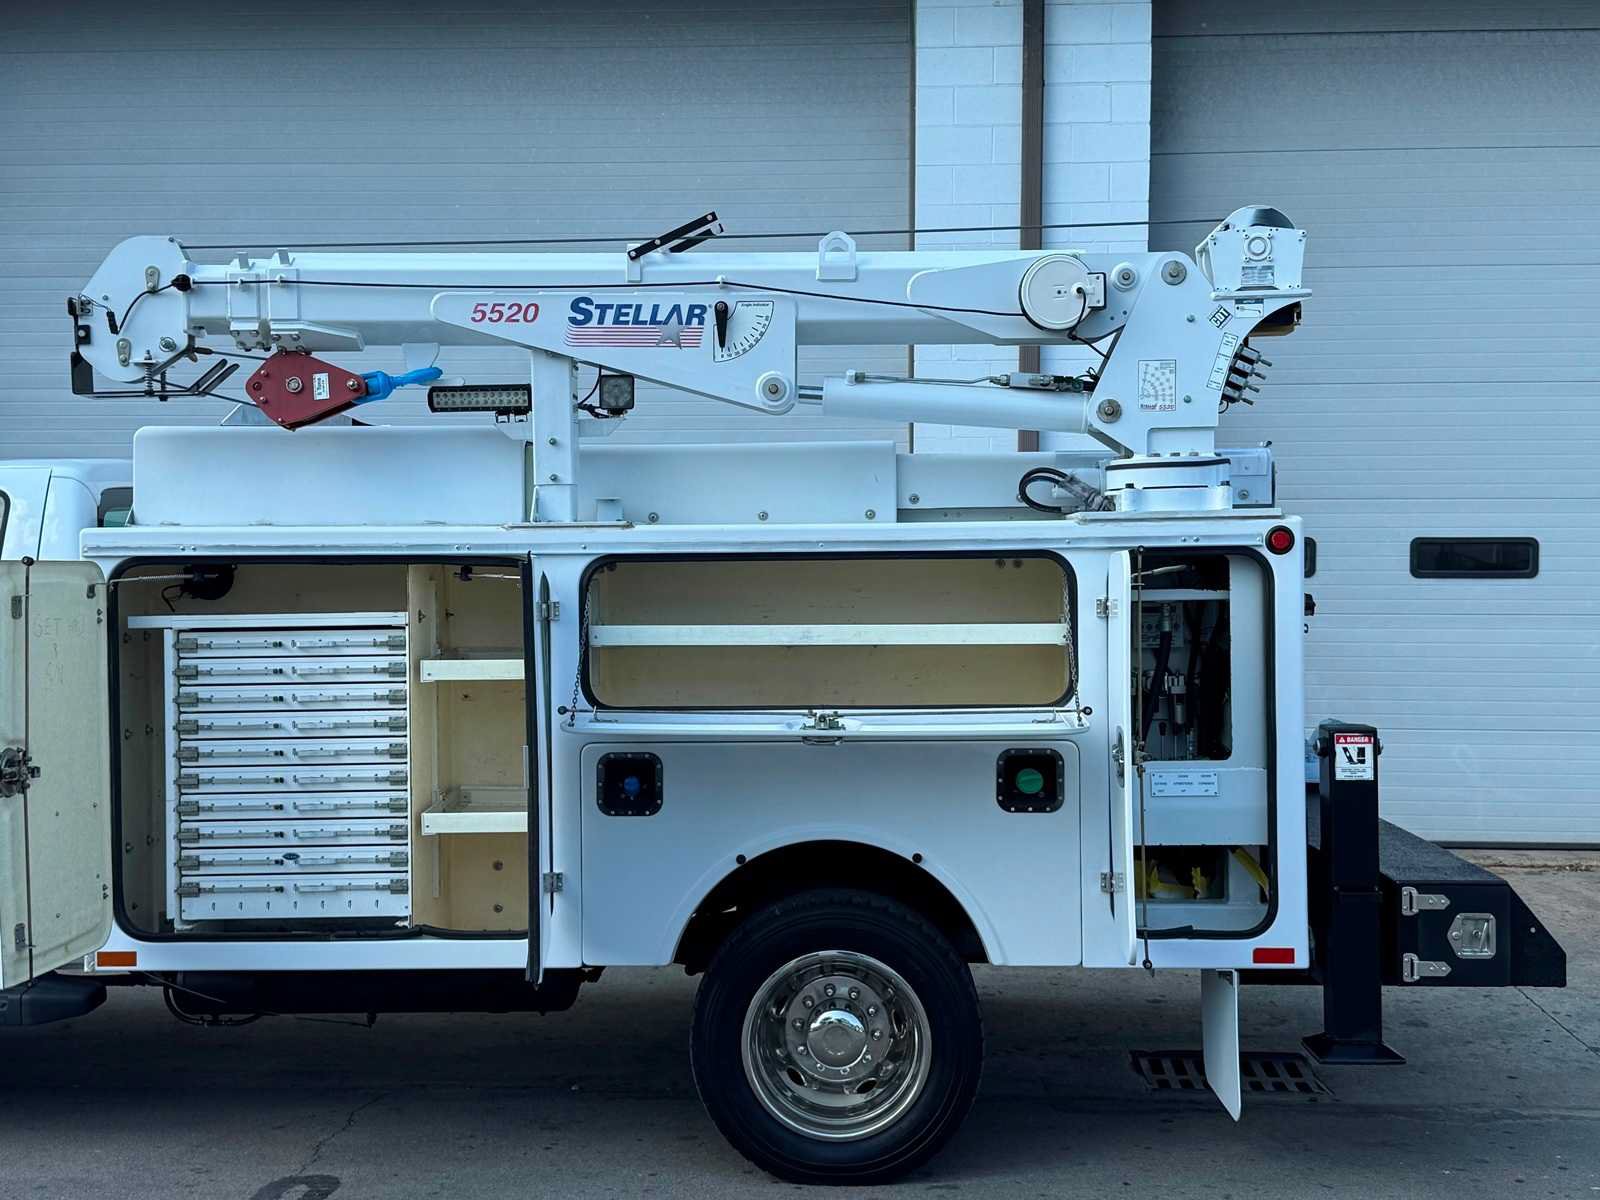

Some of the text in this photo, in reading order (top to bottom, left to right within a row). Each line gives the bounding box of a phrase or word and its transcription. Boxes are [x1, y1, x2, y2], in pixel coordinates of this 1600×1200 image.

[470, 303, 540, 323] 5520
[567, 296, 707, 326] STELLAR
[1210, 307, 1230, 327] CDT
